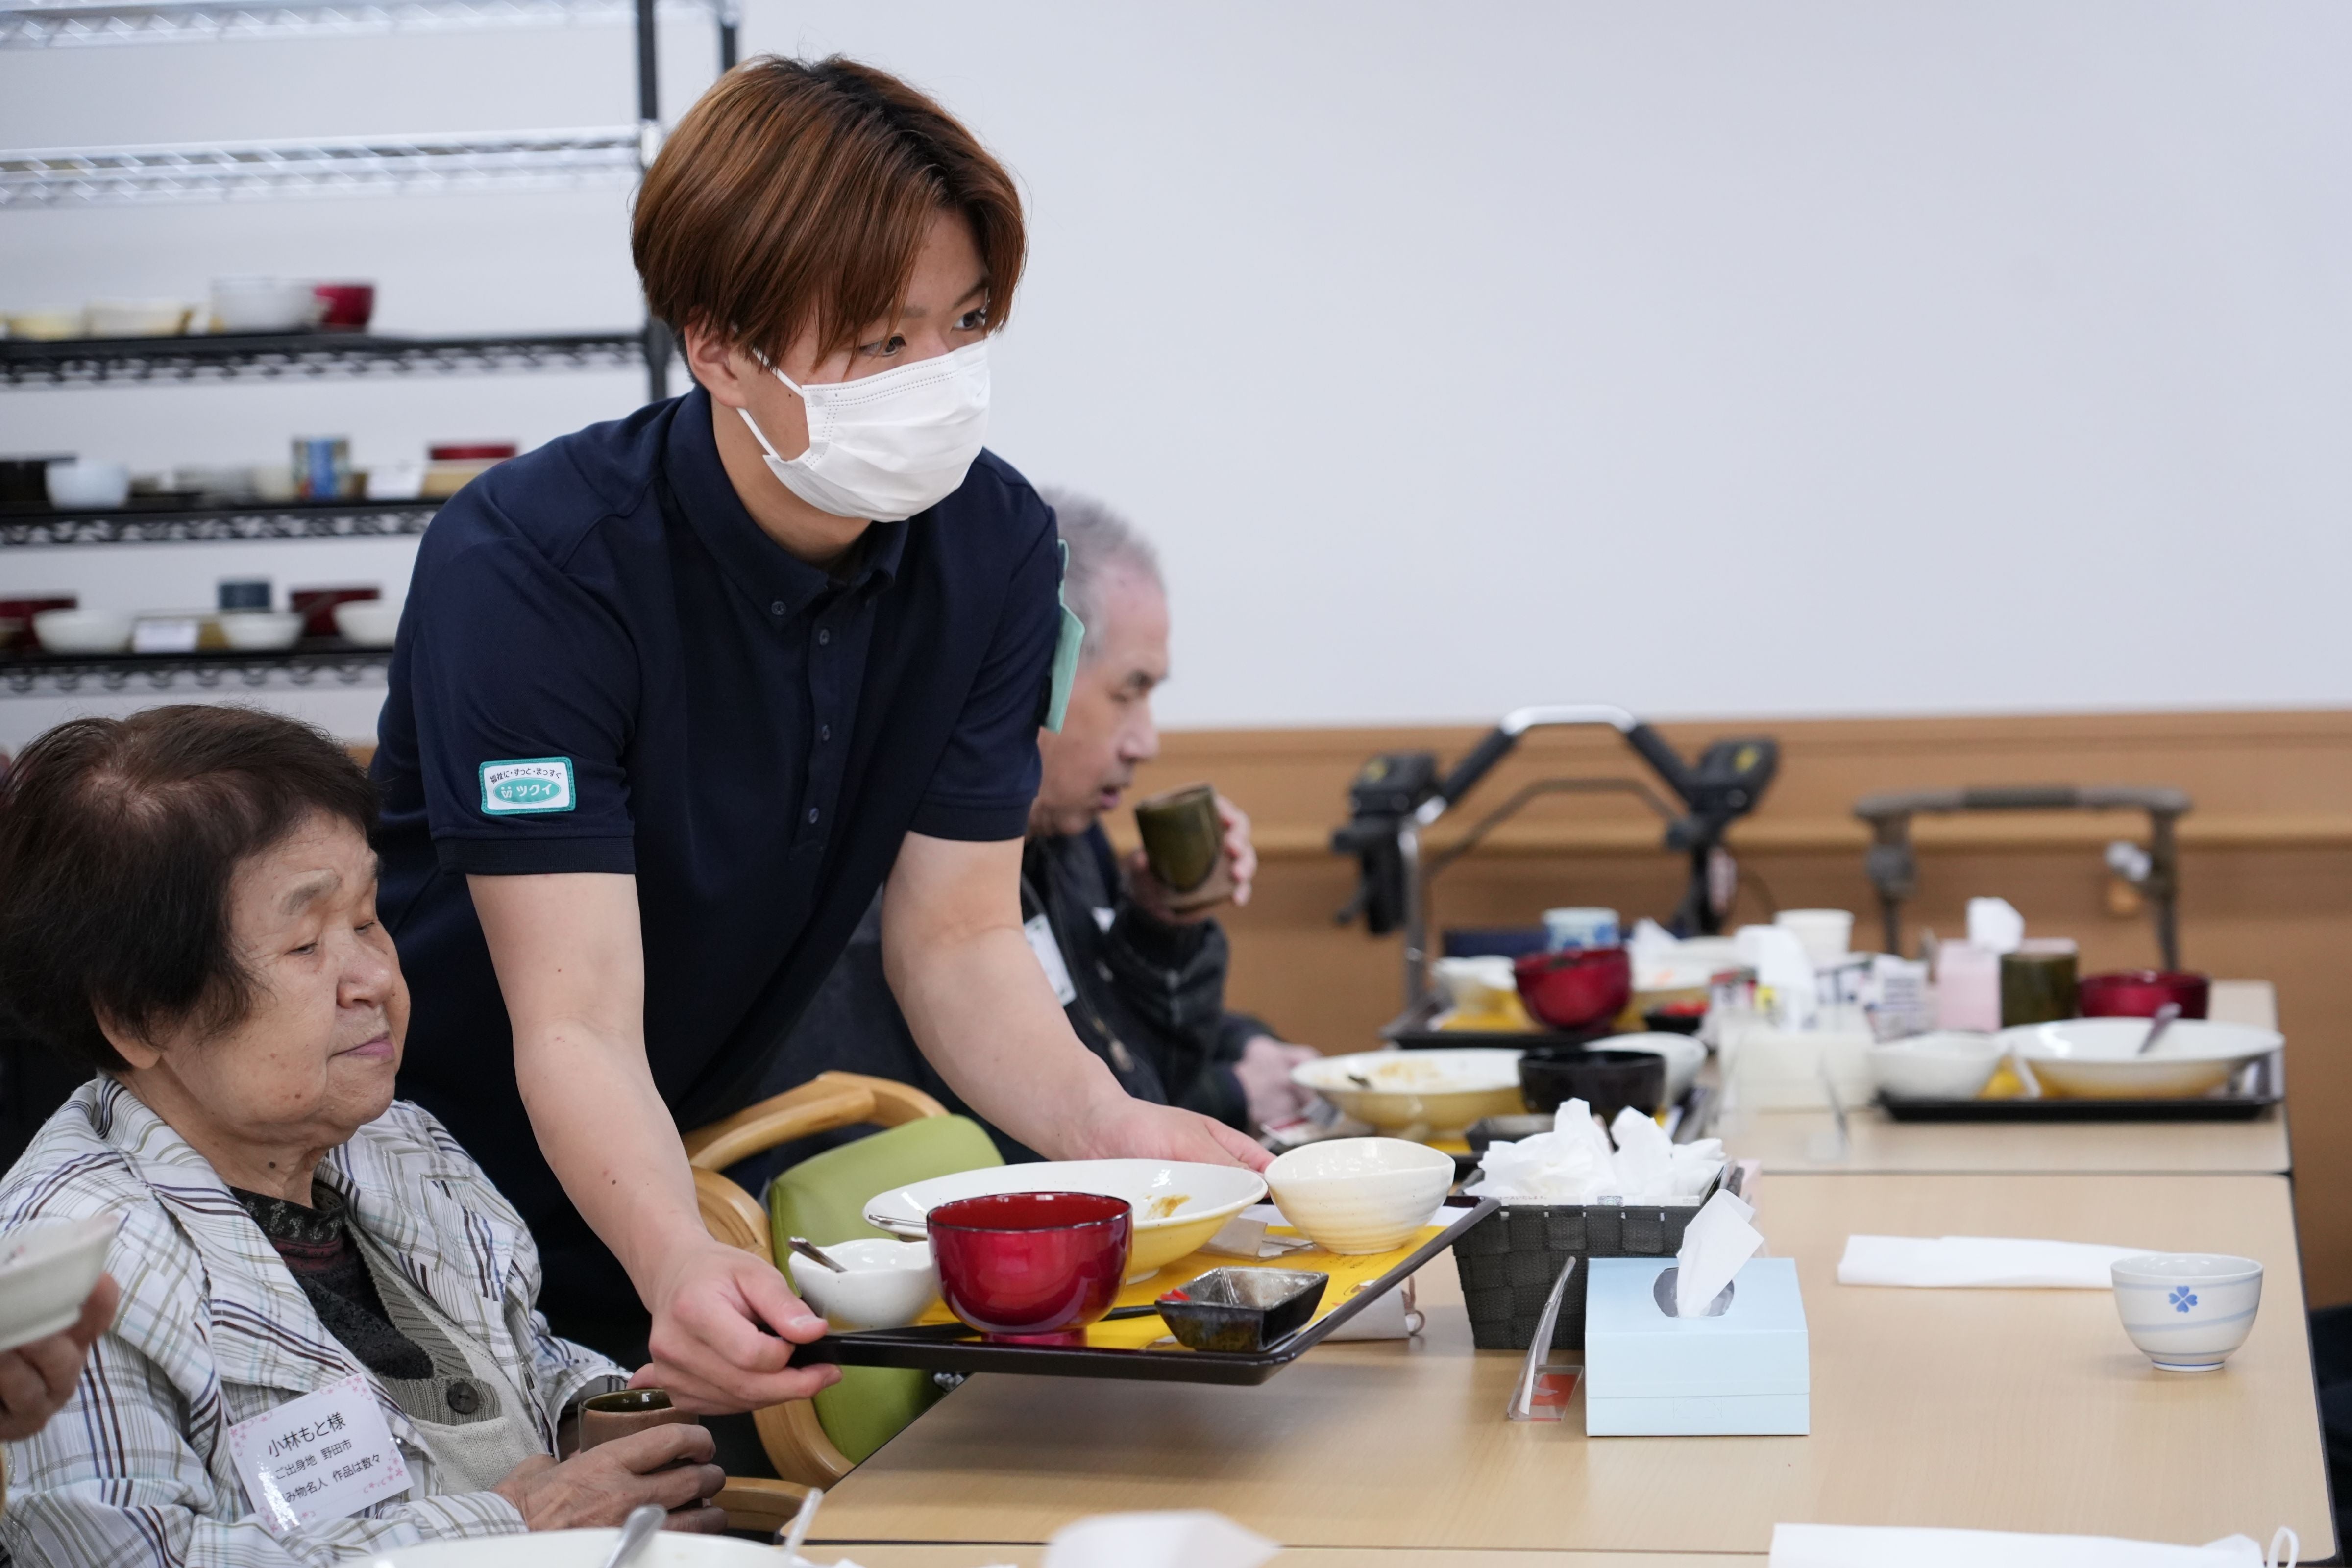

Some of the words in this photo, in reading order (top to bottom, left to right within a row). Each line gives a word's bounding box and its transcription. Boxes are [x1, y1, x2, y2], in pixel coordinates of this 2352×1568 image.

[517, 784, 552, 796] ツクイ
[269, 1412, 346, 1457] 小林もと様
[275, 1454, 317, 1480] ご出身地
[321, 1439, 352, 1460] 野田市
[282, 1477, 328, 1502] み物名人
[332, 1454, 381, 1482] 作品は数々
